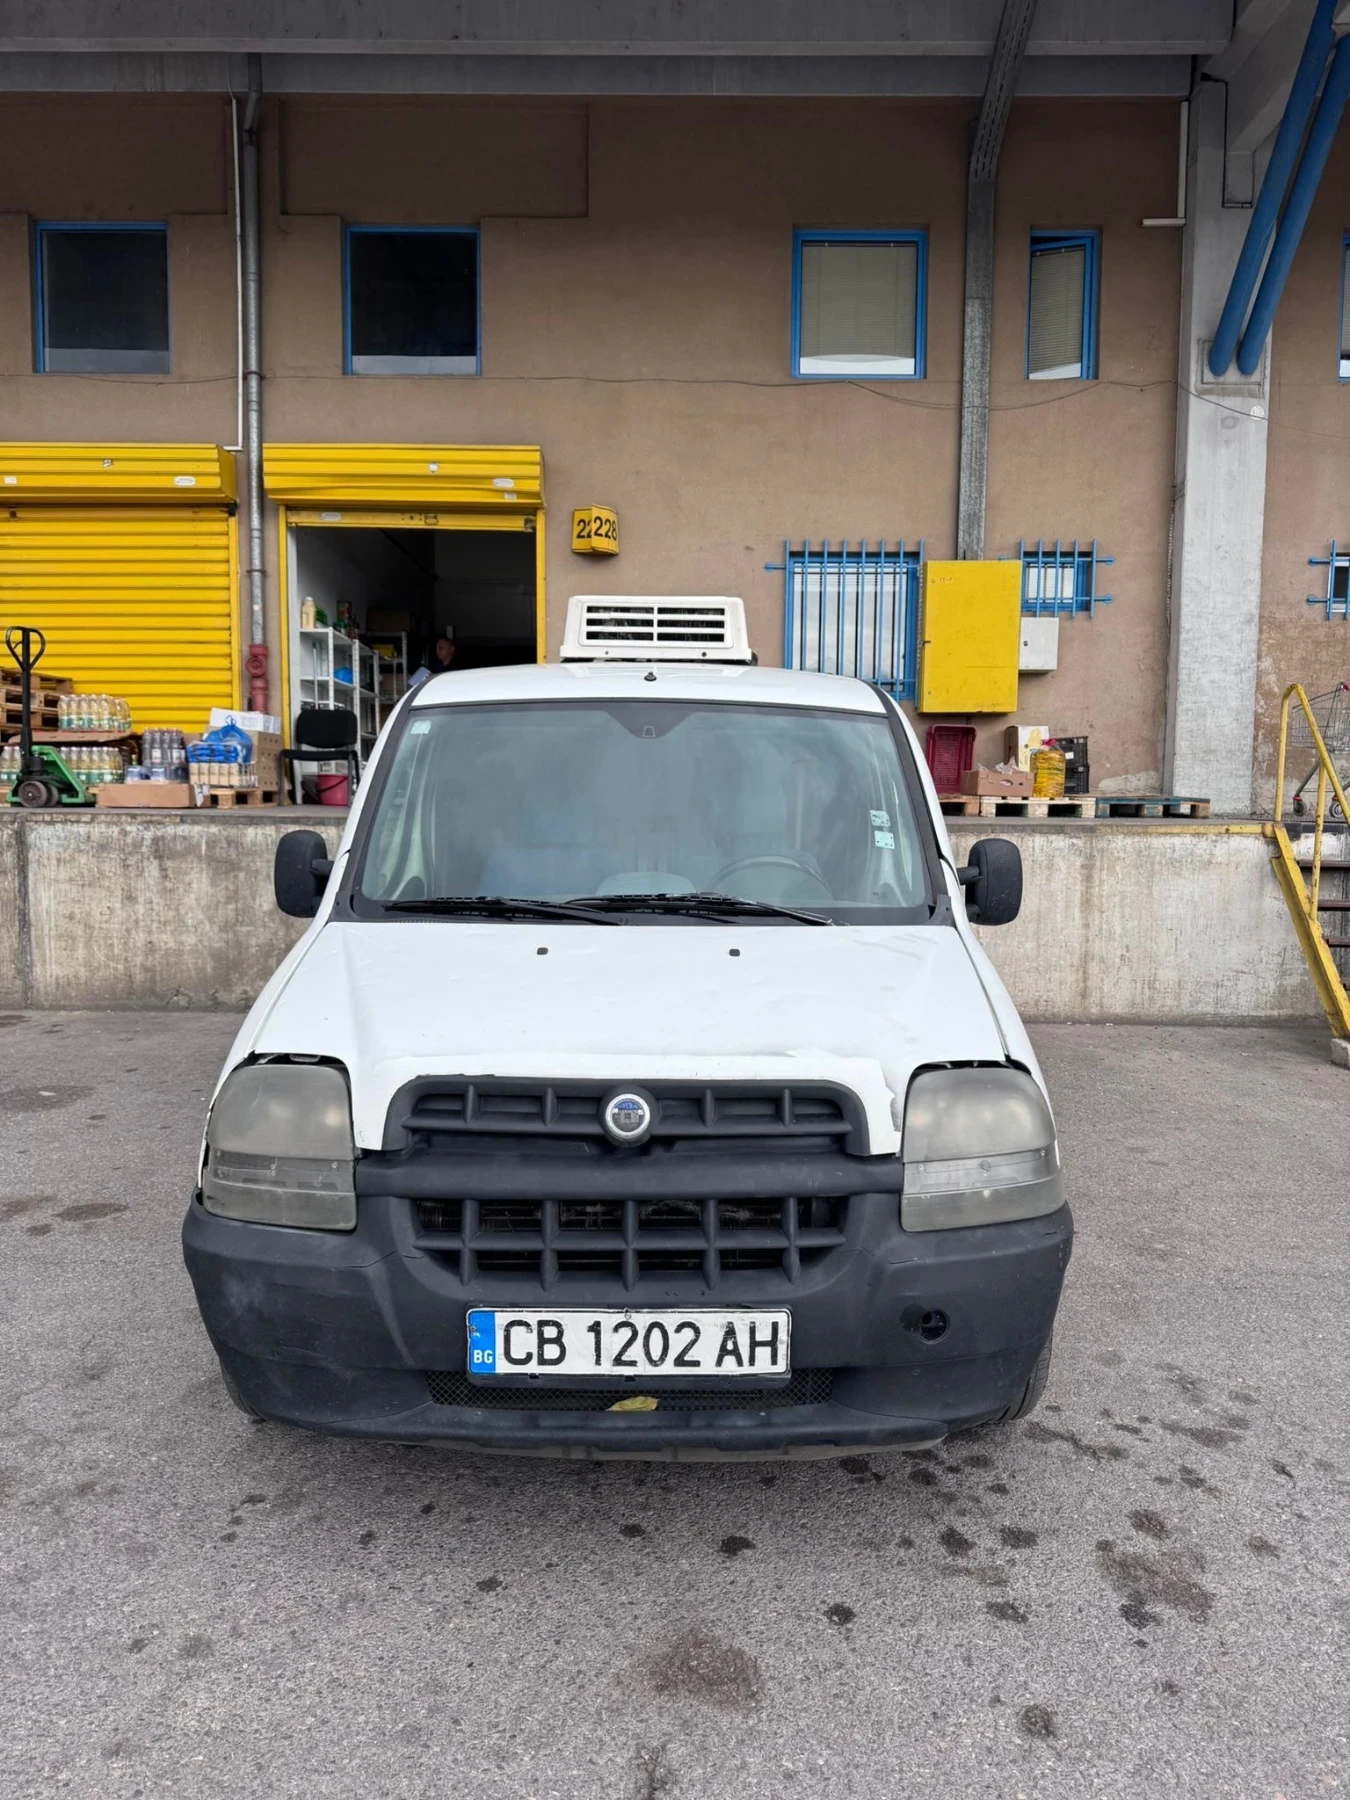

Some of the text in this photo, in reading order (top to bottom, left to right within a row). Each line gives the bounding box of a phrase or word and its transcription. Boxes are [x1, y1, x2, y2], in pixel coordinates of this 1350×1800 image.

[593, 515, 617, 541] 228
[503, 1319, 779, 1367] CB 1202 AH
[473, 1350, 493, 1364] BG
